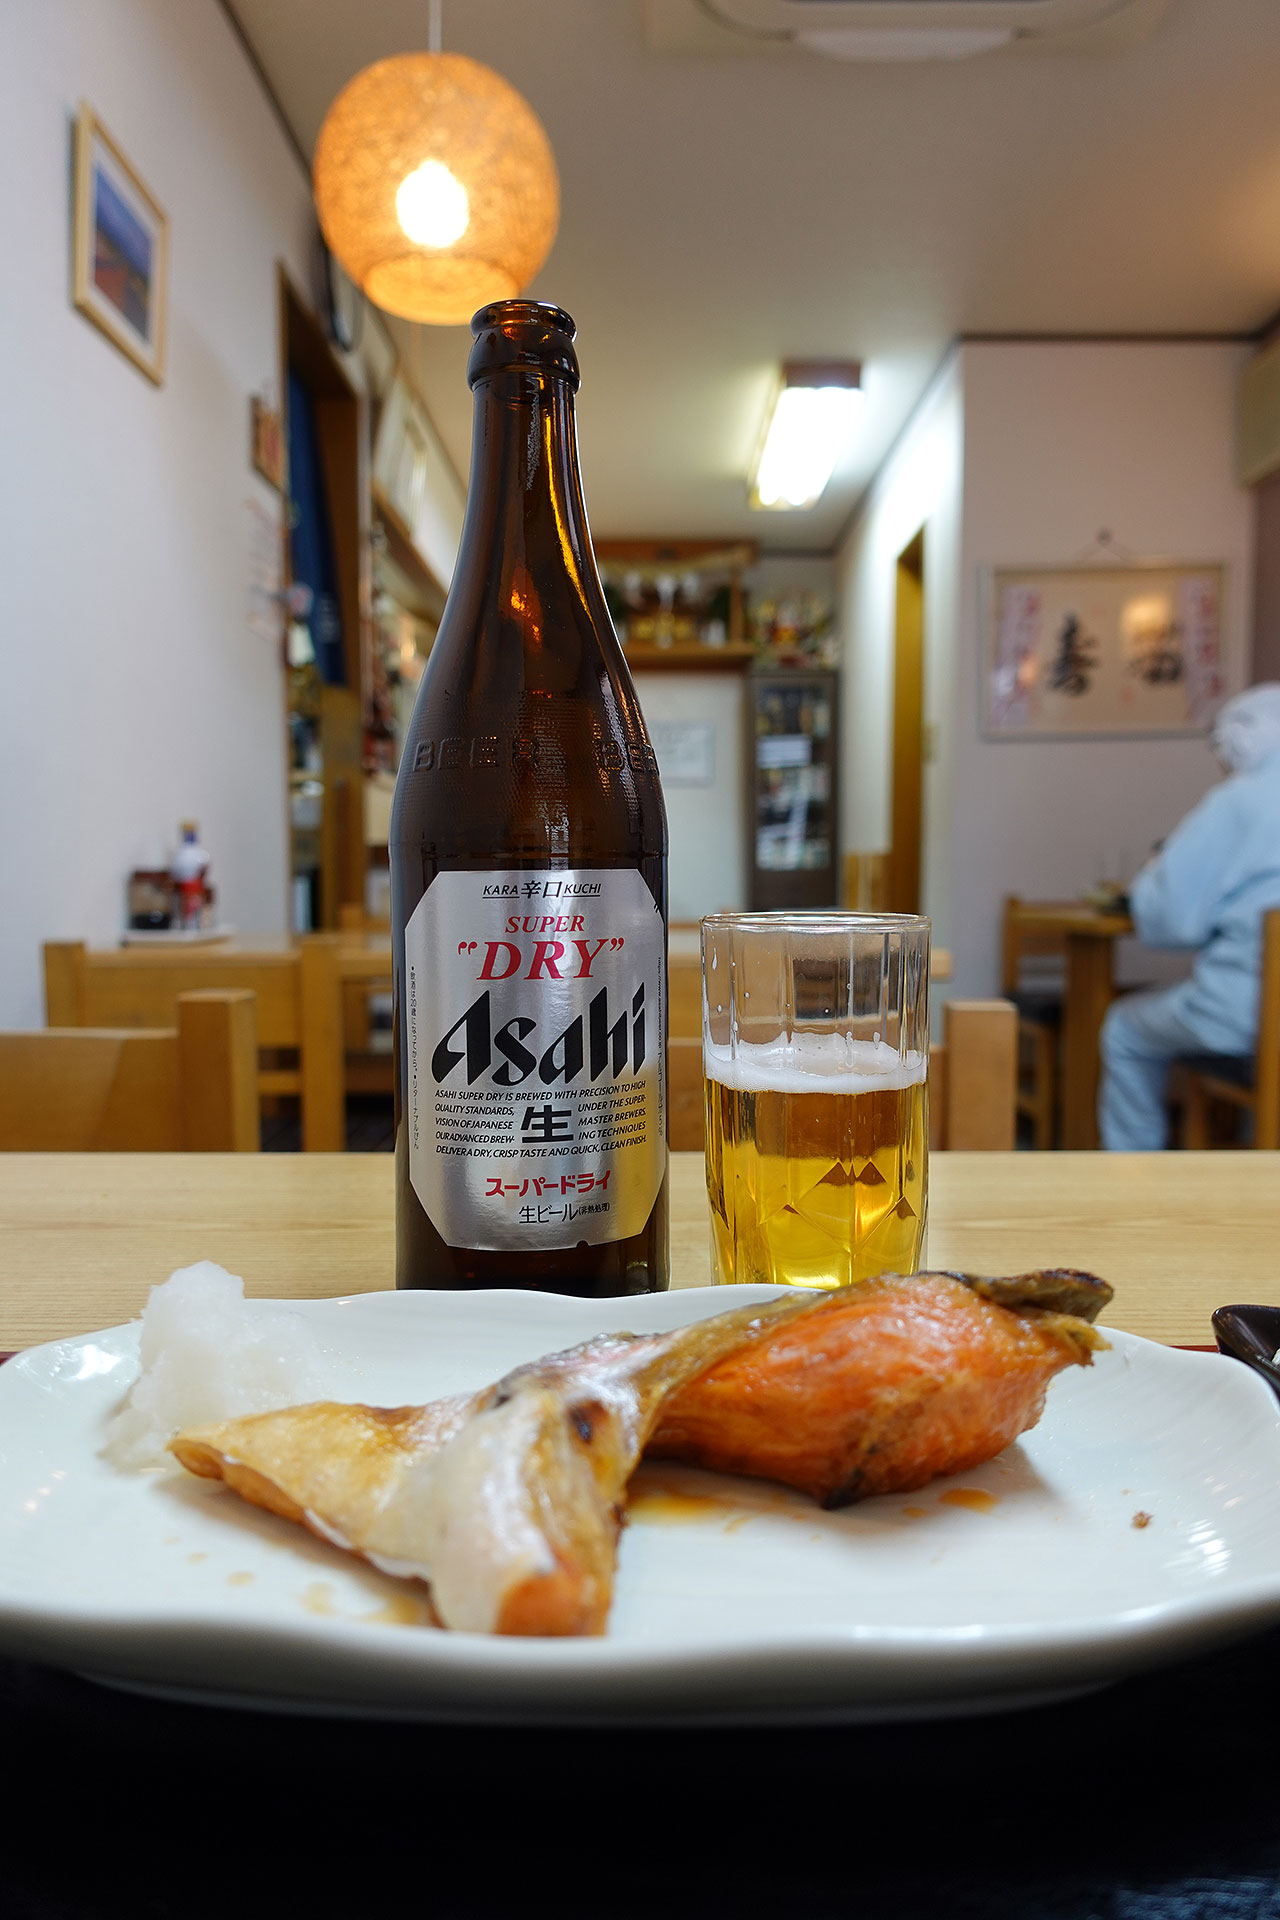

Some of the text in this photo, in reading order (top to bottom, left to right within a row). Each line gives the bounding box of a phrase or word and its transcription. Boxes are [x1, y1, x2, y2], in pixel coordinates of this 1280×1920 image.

[483, 885, 519, 895] KARA
[520, 880, 562, 899] 辛口
[564, 883, 602, 894] KUCHI
[505, 915, 585, 933] SUPER
[432, 982, 645, 1086] Asahi
[435, 1081, 646, 1101] ASAHI SUPER DRY IS BREWED WITH PRECISION TO HIGH
[435, 1103, 515, 1116] QUALITY STANDARDS,
[578, 1103, 608, 1112] UNDER
[609, 1100, 624, 1108] THE
[436, 1117, 513, 1129] VISION OF JAPANESE
[521, 1105, 574, 1143] 生
[578, 1107, 646, 1126] MASTER BREWERS
[436, 1131, 515, 1143] OUR ADVANCED BREW-
[578, 1121, 646, 1140] ING TECHNIQUES
[436, 1145, 467, 1156] DELIVER
[474, 1149, 492, 1158] DRY,
[493, 1149, 519, 1157] CRISP
[520, 1149, 546, 1158] TASTE
[548, 1147, 569, 1156] AND
[571, 1144, 600, 1154] QUICK,
[601, 1139, 625, 1151] CLEAN
[486, 1170, 611, 1197] スーパードライ
